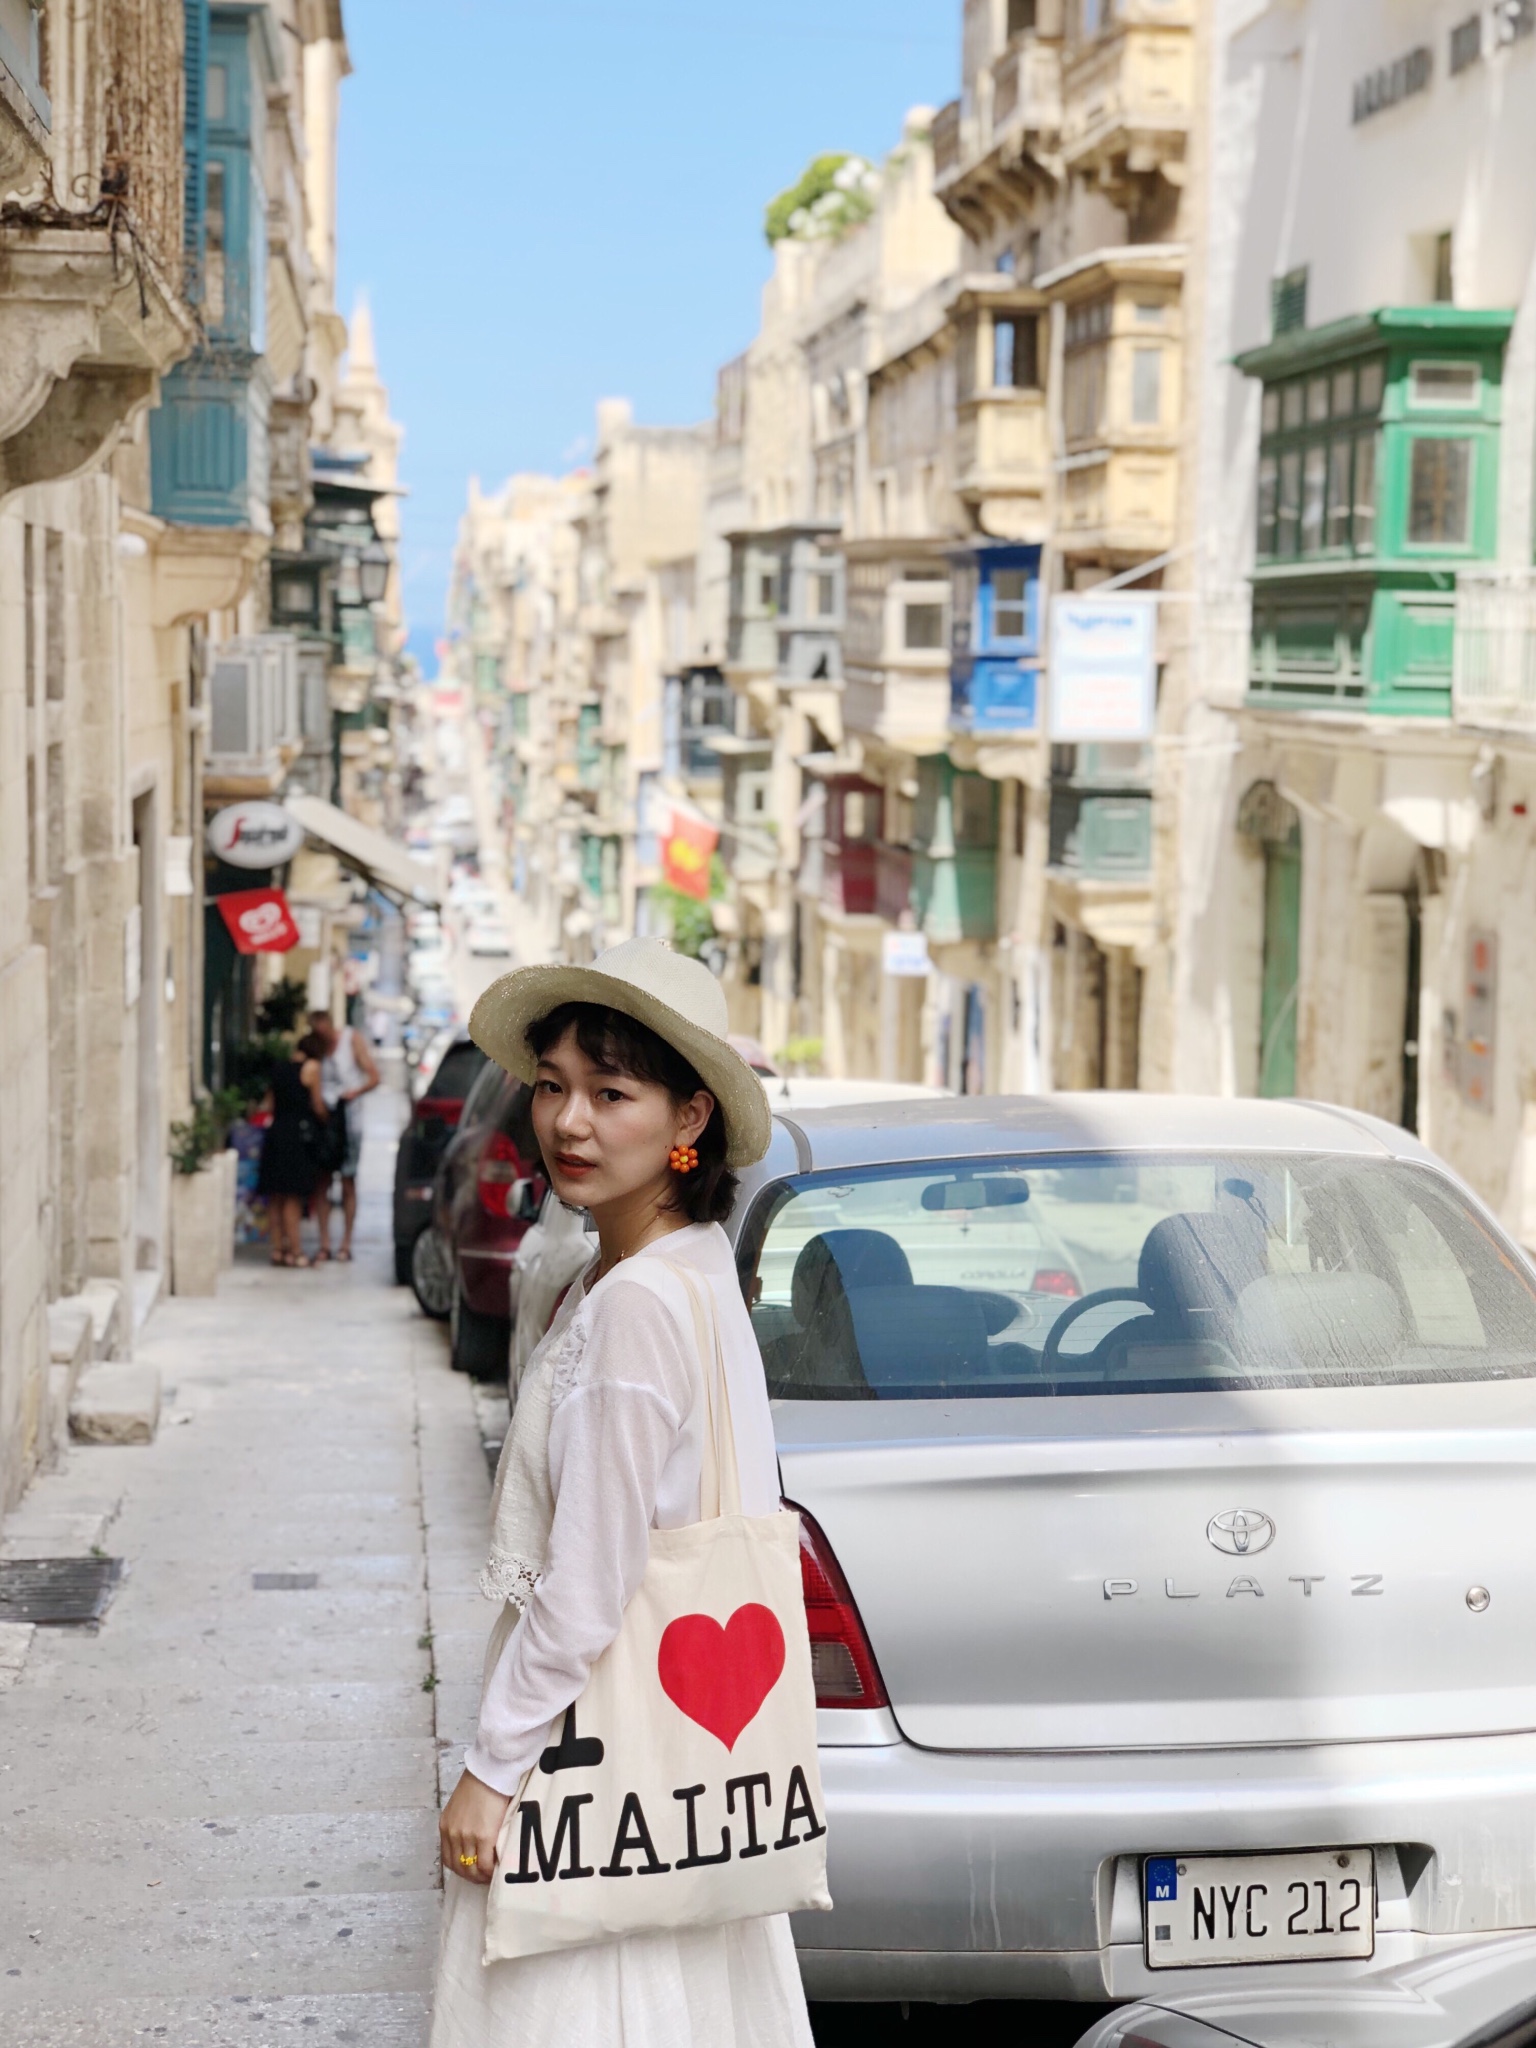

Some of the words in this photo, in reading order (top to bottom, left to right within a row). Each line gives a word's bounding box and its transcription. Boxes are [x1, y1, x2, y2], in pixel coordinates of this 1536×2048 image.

[1103, 1573, 1384, 1600] PLATZ
[504, 1765, 827, 1884] MALTA
[1155, 1885, 1170, 1898] M
[1193, 1883, 1268, 1940] NYC
[1287, 1878, 1361, 1935] 212
